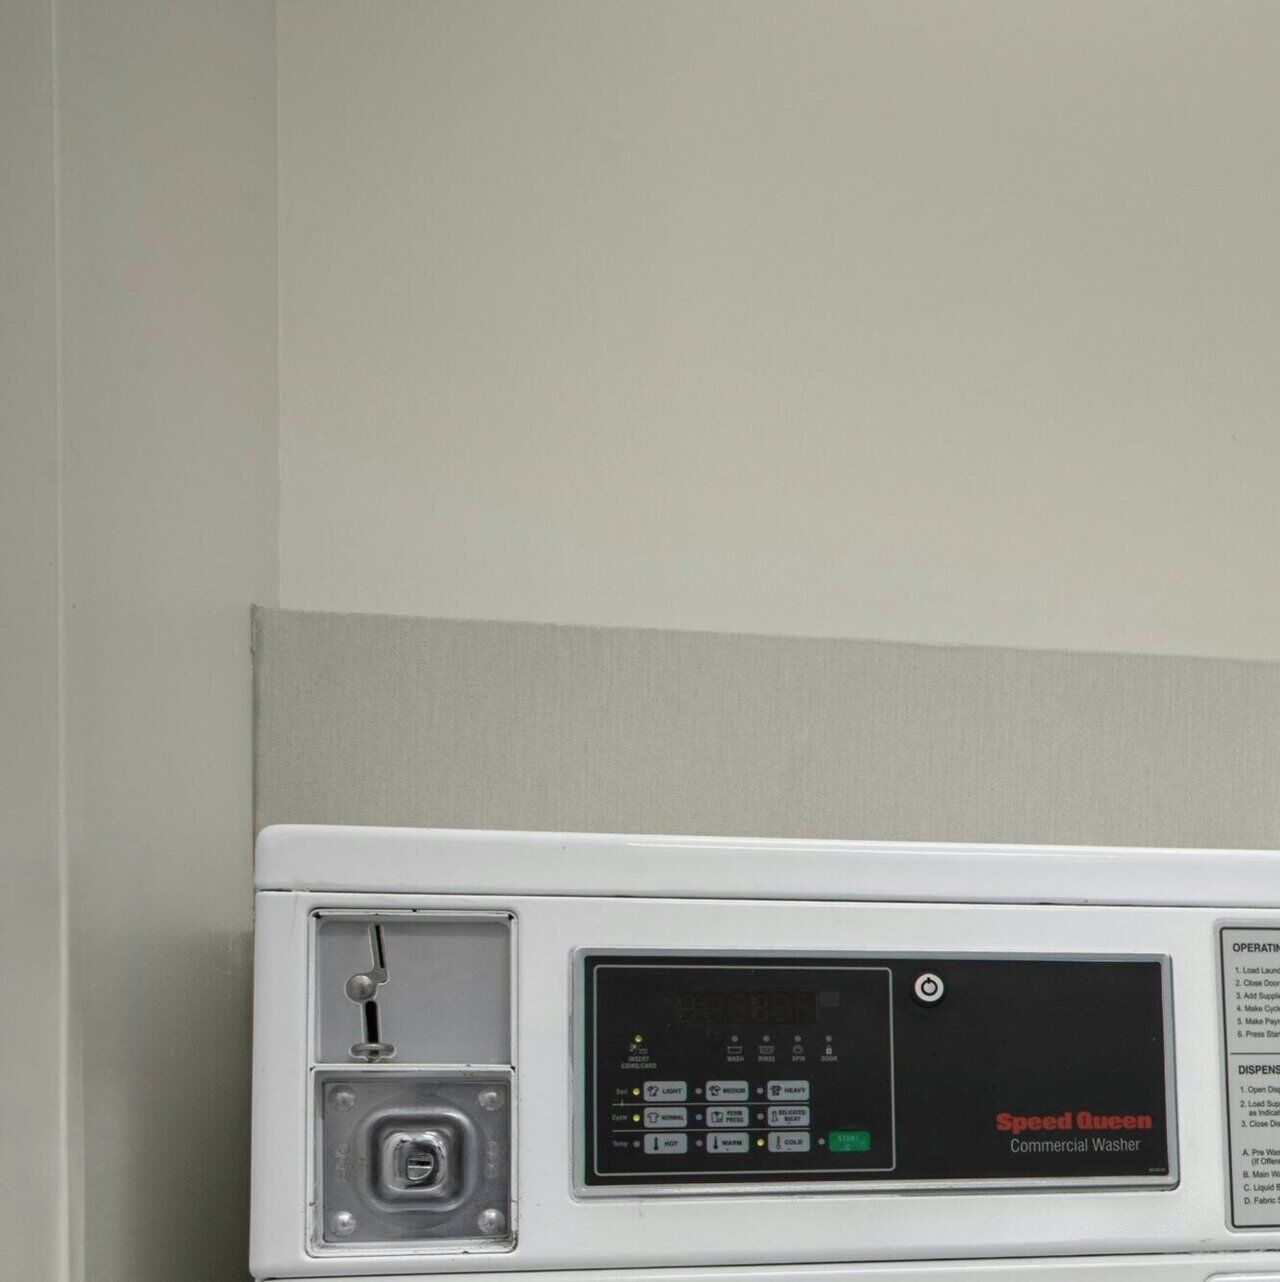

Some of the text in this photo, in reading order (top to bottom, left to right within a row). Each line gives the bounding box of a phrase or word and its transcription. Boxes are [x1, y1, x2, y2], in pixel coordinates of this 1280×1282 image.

[1248, 1086, 1266, 1094] Open
[997, 1112, 1151, 1134] Speed Queen
[1011, 1138, 1140, 1152] Commercial Washer
[1253, 1184, 1274, 1192] Liquid
